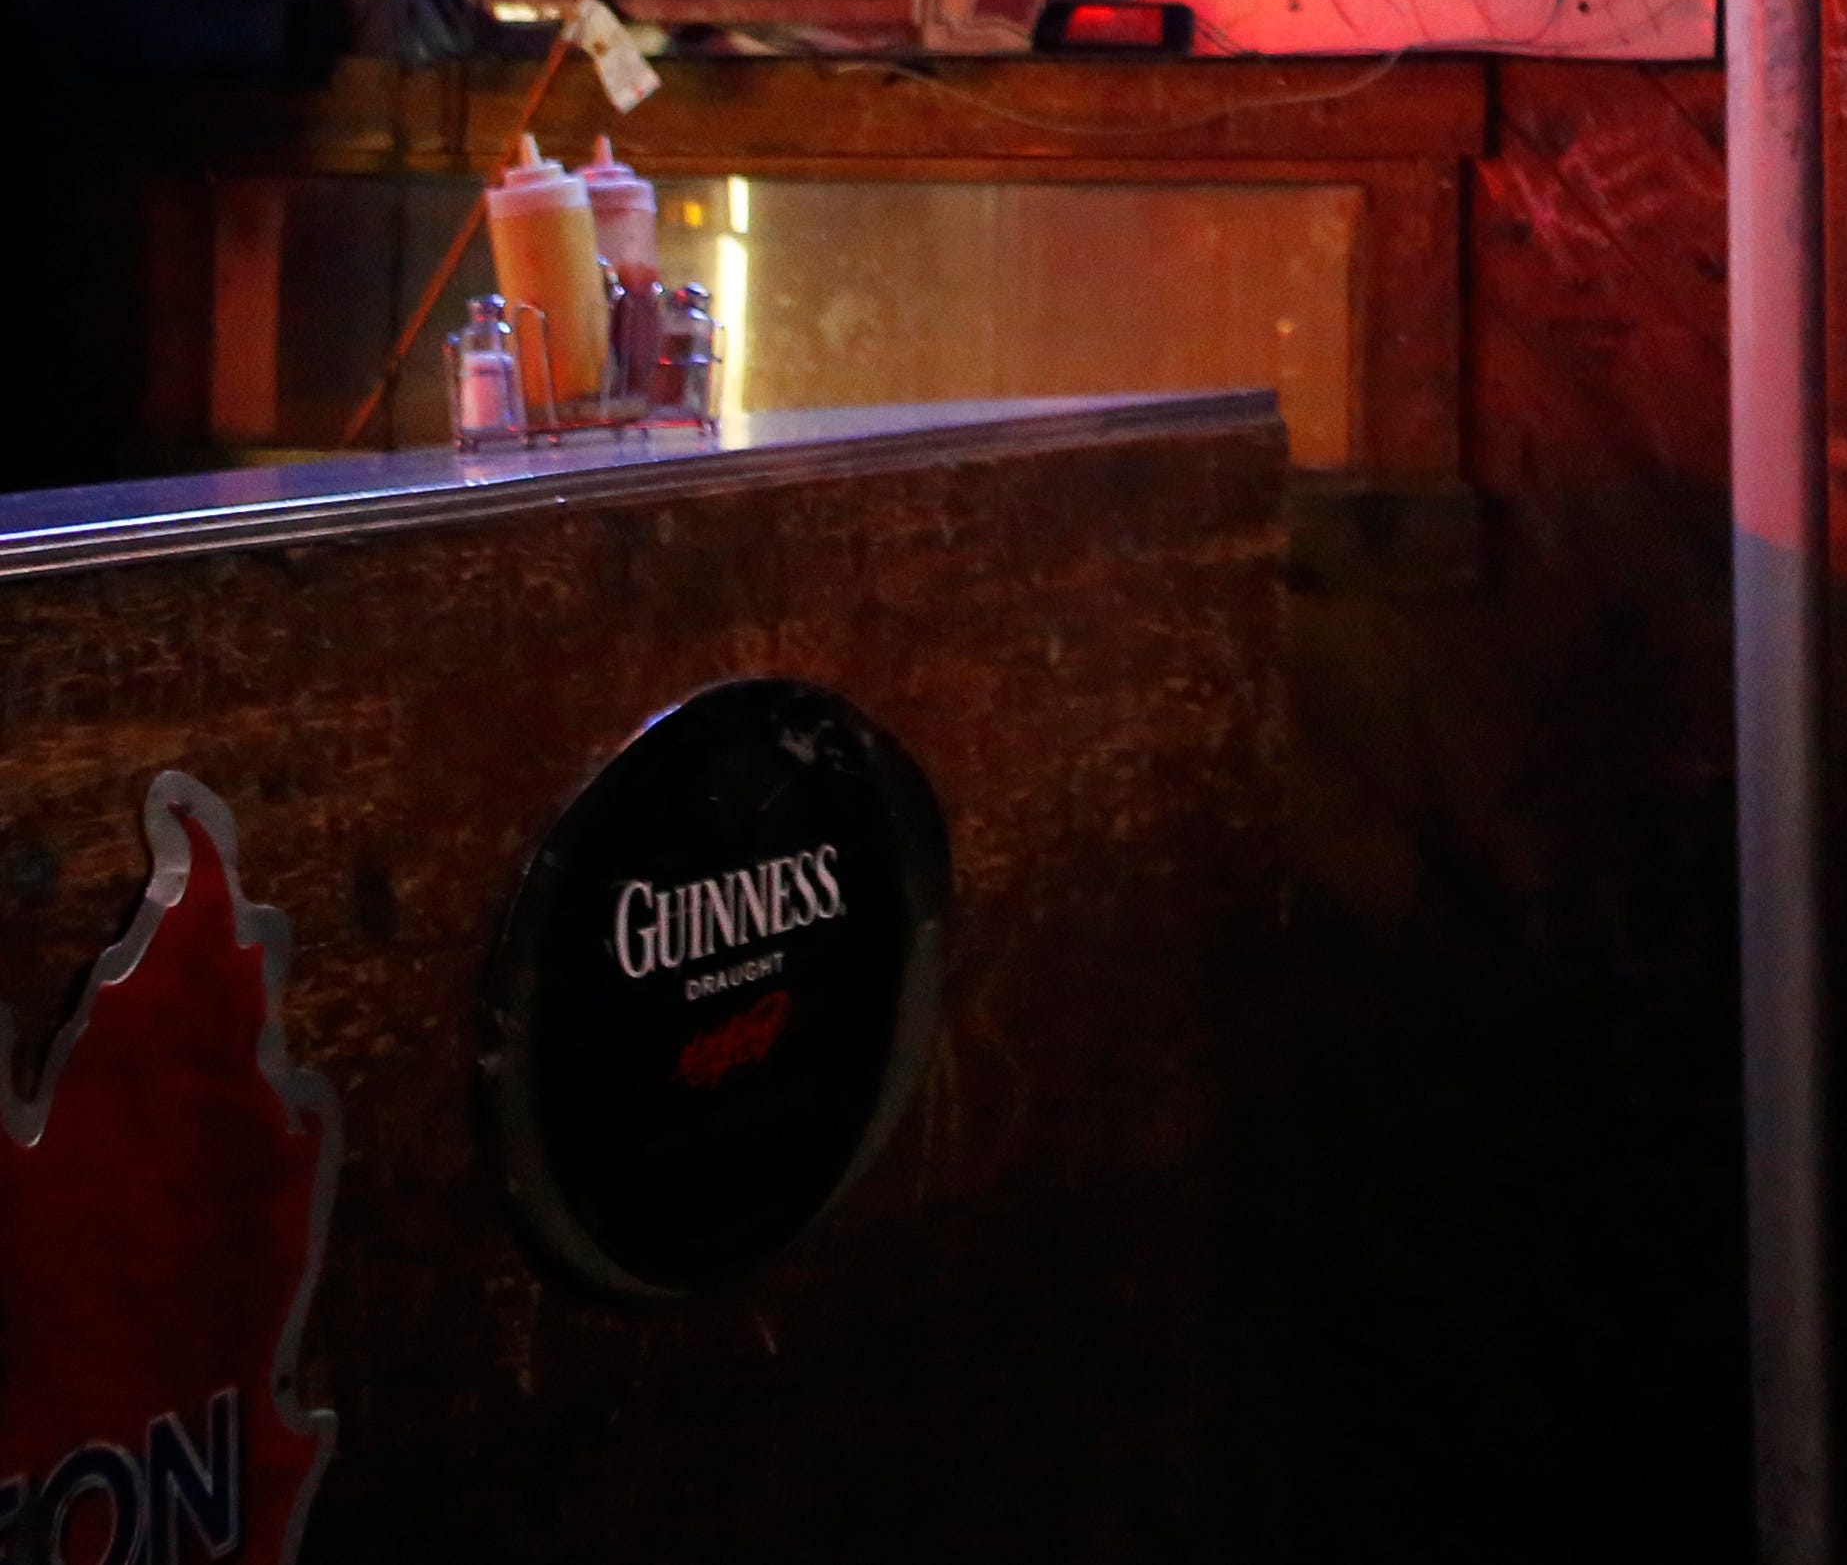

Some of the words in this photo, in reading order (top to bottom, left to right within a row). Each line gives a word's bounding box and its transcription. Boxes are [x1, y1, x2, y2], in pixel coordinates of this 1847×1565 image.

[612, 841, 843, 980] GUINNESS
[683, 950, 787, 1003] DRAUGHT
[0, 1393, 240, 1565] ON
